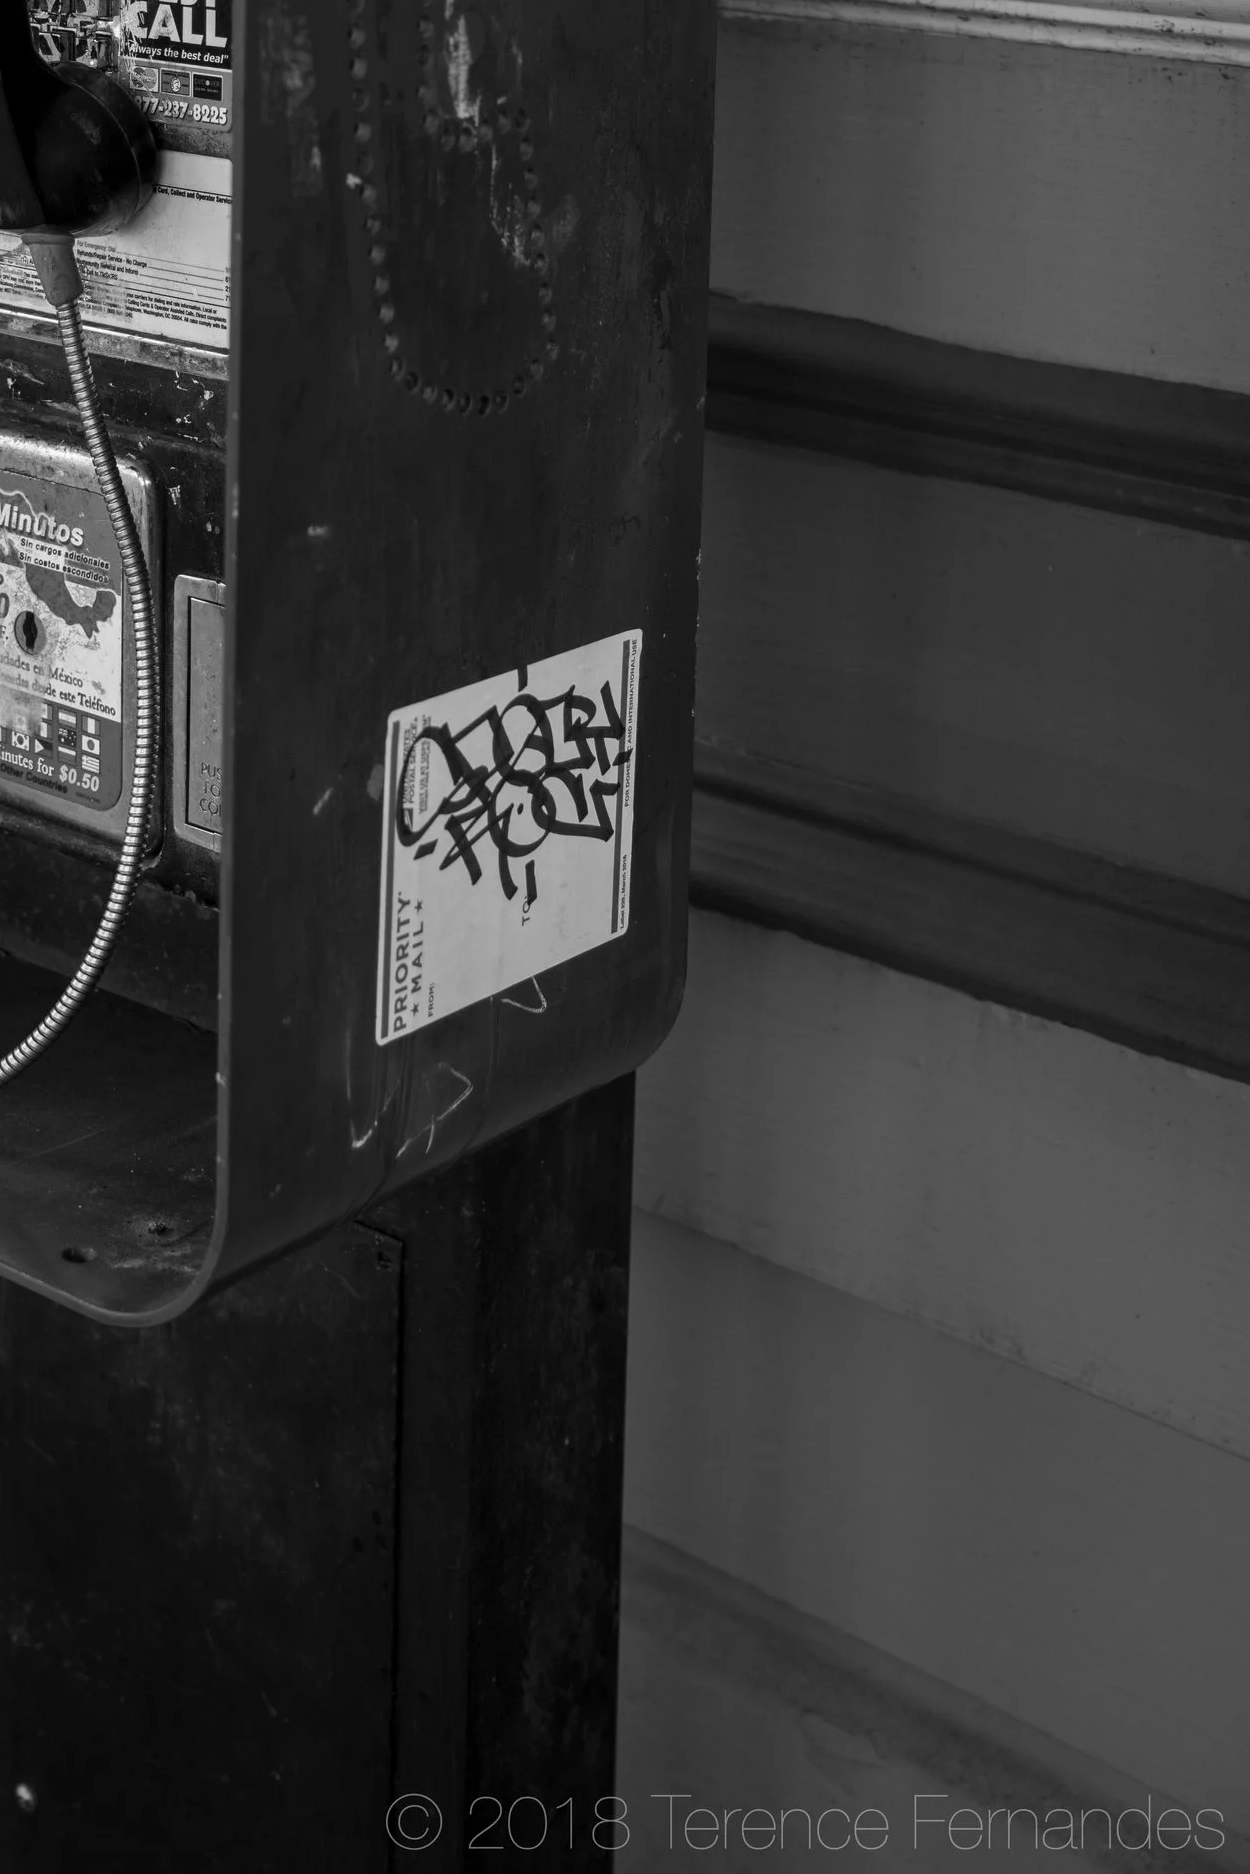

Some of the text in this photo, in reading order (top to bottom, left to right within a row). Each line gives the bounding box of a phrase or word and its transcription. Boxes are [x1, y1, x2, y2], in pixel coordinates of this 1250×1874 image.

[127, 0, 228, 48] CALL
[164, 46, 179, 57] the
[181, 49, 202, 61] best
[203, 52, 229, 64] deal"
[19, 552, 110, 584] Sin costos escondidos
[20, 537, 110, 571] Sin cargos adicionales
[50, 666, 84, 688] México
[627, 657, 636, 724] INTERNATIONAL
[32, 679, 57, 698] desde
[59, 689, 76, 703] este
[77, 692, 116, 717] Teléfono
[0, 763, 68, 794] Other Countries
[37, 757, 55, 776] for
[59, 764, 100, 792] $0.50
[201, 762, 222, 781] PUS
[411, 921, 424, 995] MAIL
